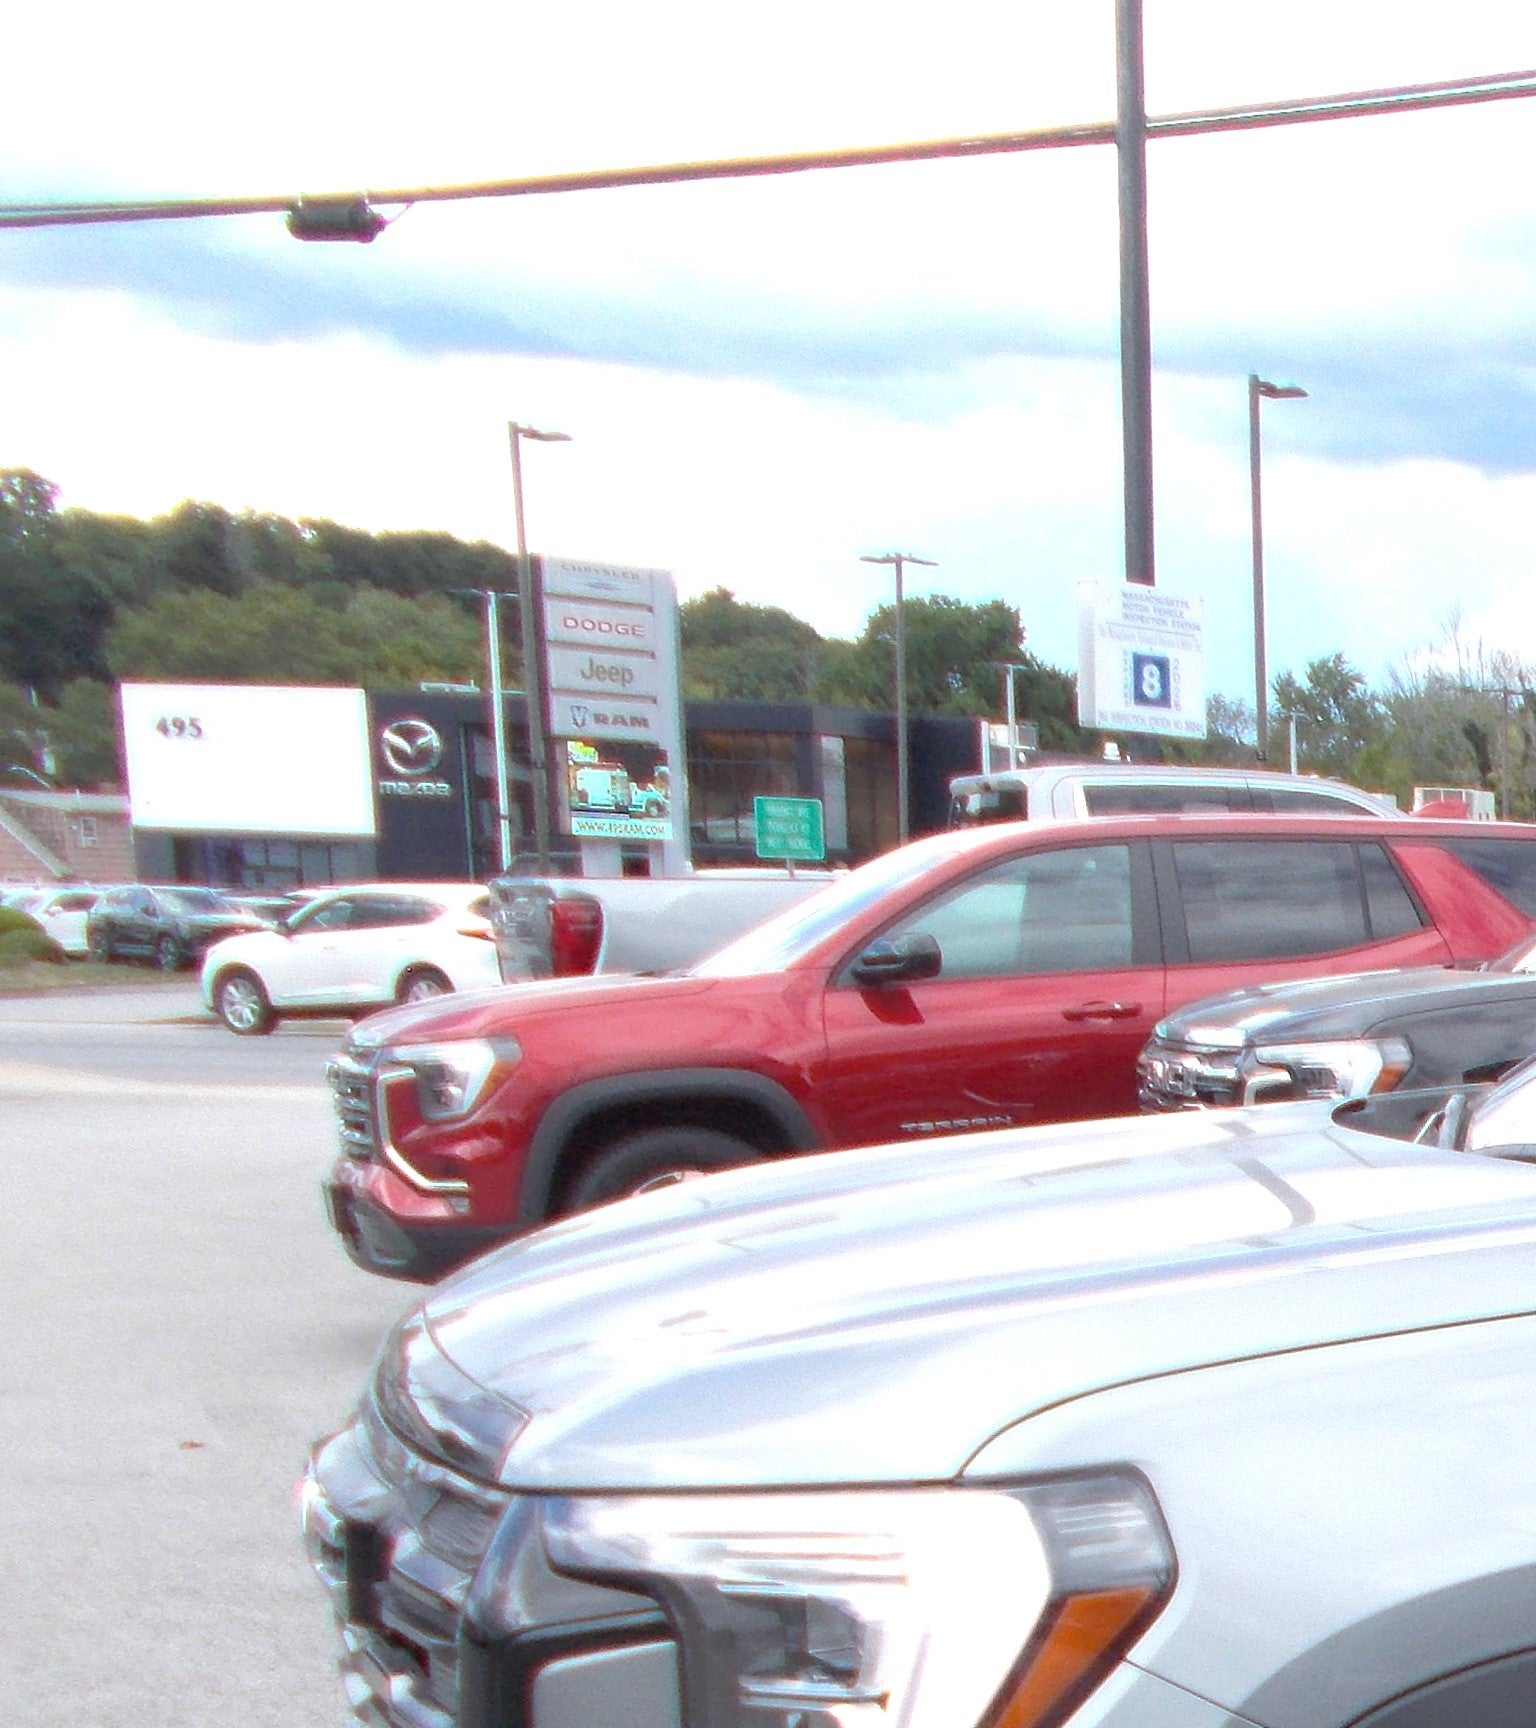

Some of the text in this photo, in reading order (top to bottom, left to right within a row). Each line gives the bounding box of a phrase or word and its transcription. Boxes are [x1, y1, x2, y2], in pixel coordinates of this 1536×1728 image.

[562, 563, 640, 580] CHRYSLER
[563, 617, 646, 637] DODGE
[580, 658, 634, 686] Jeep
[1142, 663, 1163, 699] 8
[155, 717, 203, 739] 495
[593, 712, 650, 729] RAM
[379, 781, 450, 796] mazda
